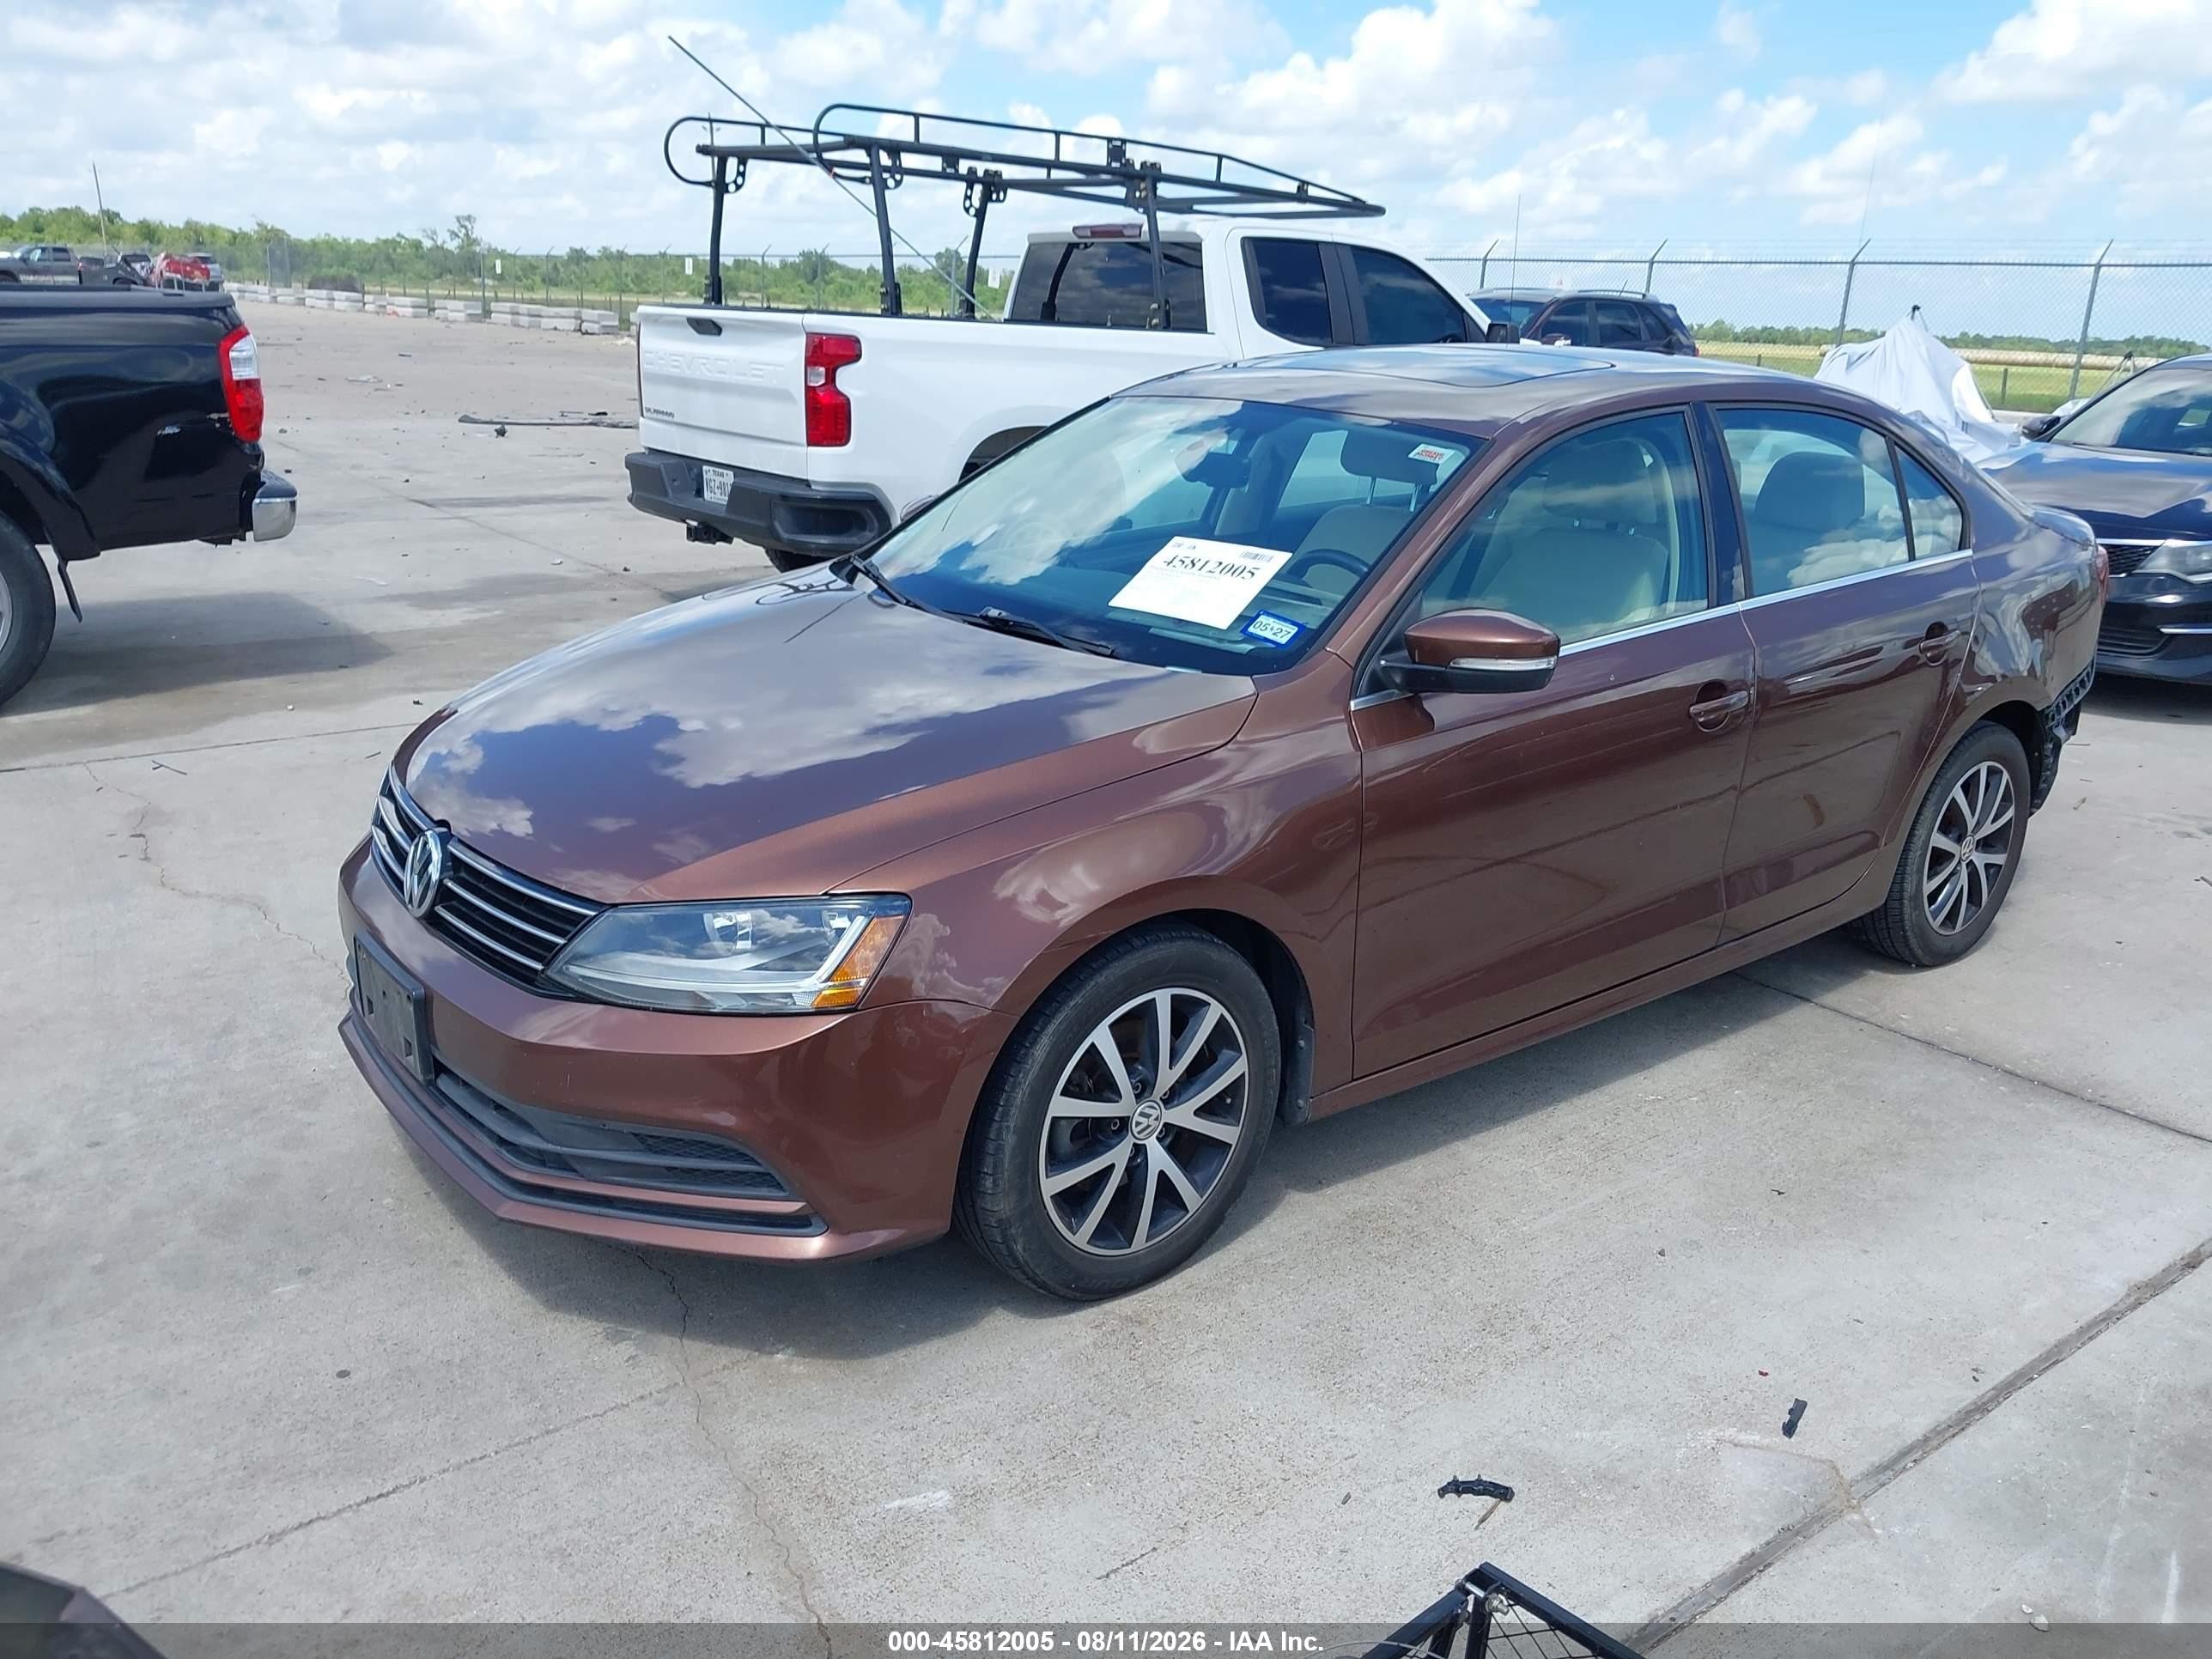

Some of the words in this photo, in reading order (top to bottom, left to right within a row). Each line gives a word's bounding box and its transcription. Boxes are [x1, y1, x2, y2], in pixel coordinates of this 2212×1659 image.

[644, 350, 785, 384] CHEVROLET
[1163, 554, 1261, 580] 45812005
[1253, 620, 1272, 632] 05
[1272, 627, 1291, 639] 27
